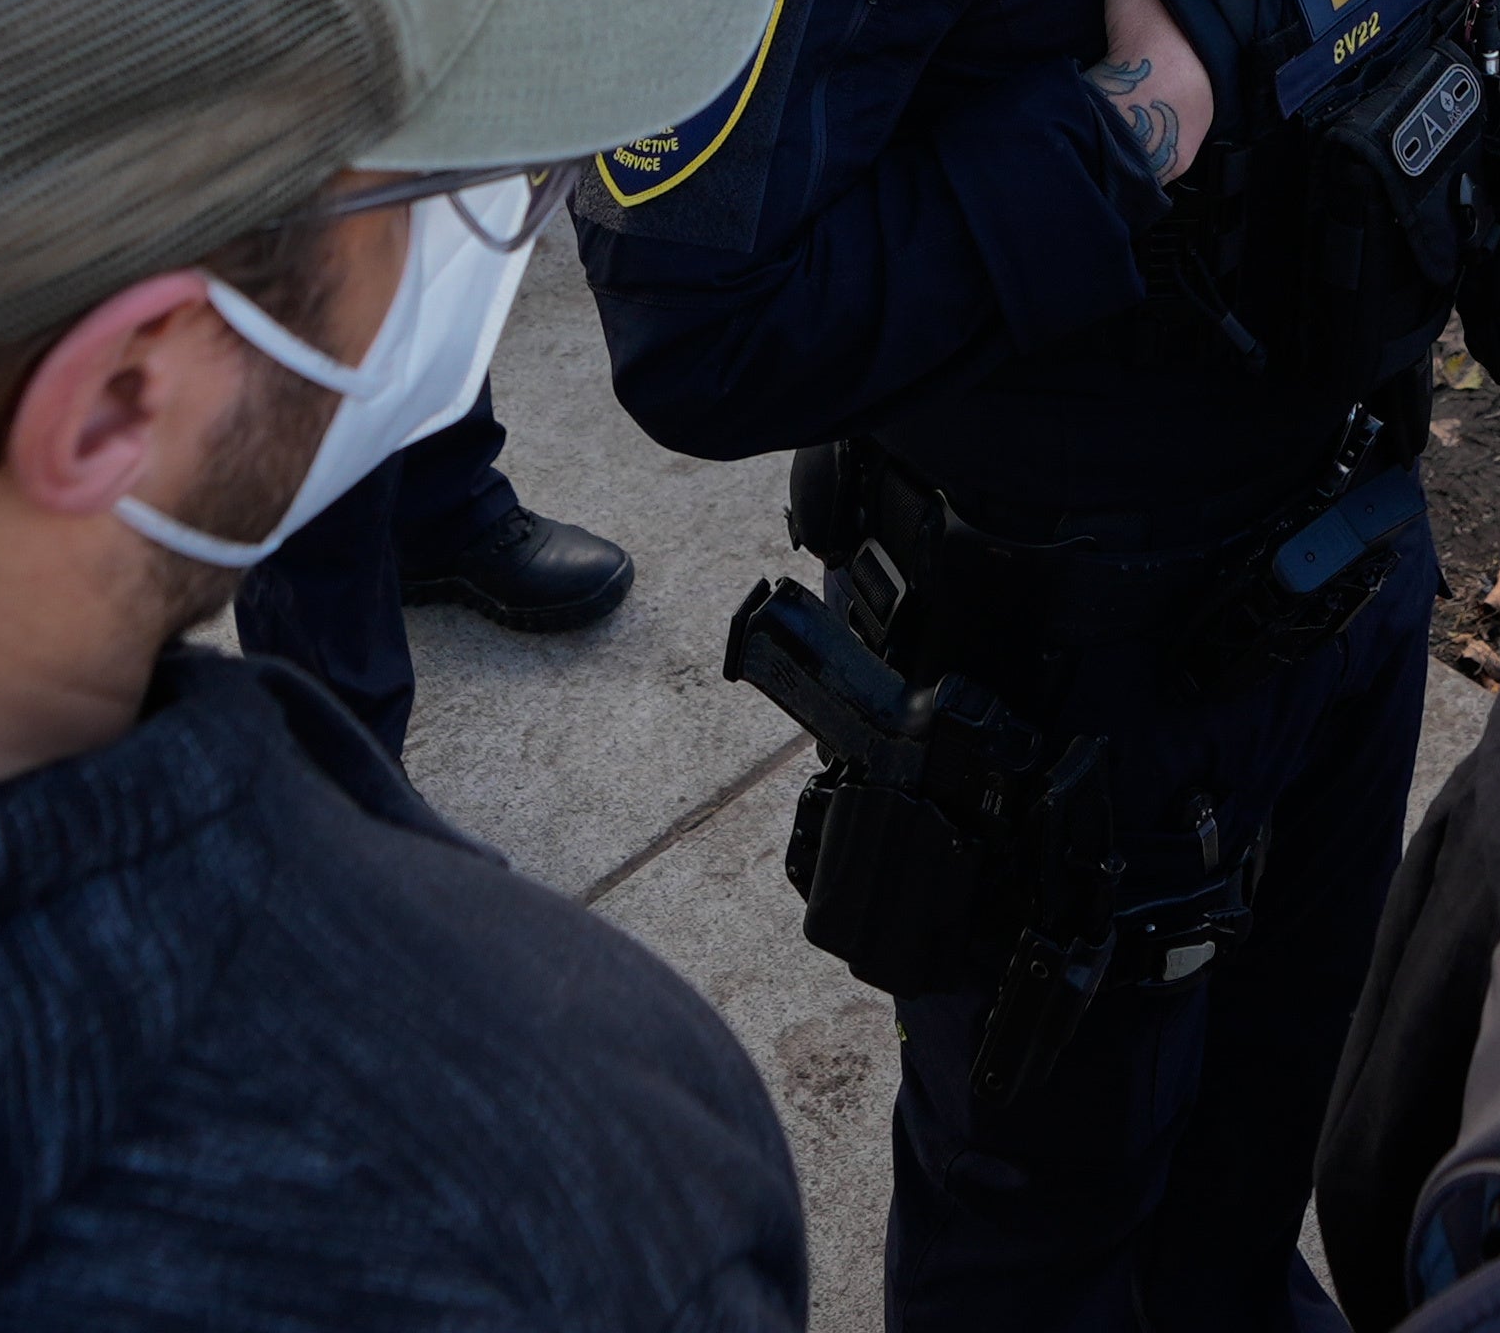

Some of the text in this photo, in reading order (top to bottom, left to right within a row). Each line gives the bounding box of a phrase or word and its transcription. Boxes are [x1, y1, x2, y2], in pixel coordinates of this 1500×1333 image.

[1332, 10, 1382, 65] 8V22
[629, 137, 679, 153] ECTIVE
[1421, 111, 1446, 150] A
[613, 146, 661, 172] SERVICE
